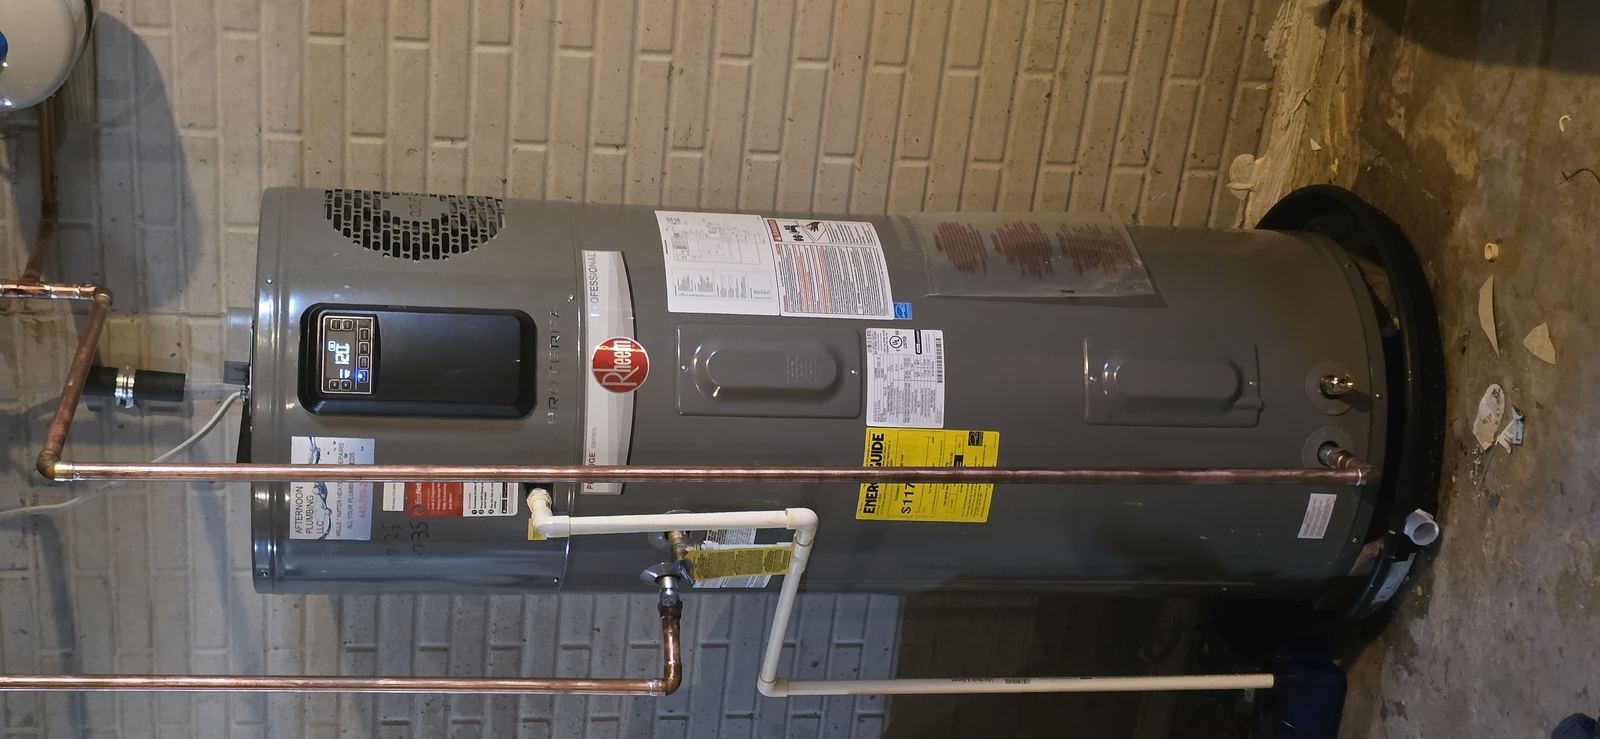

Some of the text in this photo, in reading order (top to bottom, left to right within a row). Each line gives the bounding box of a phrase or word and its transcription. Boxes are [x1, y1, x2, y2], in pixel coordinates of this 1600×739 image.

[588, 252, 600, 317] PROFESSIONAL
[592, 340, 640, 386] Rheem
[295, 486, 304, 534] AFTERNOON
[414, 482, 422, 504] EcoNet
[306, 495, 314, 534] PLUMBING
[316, 520, 324, 534] LLC
